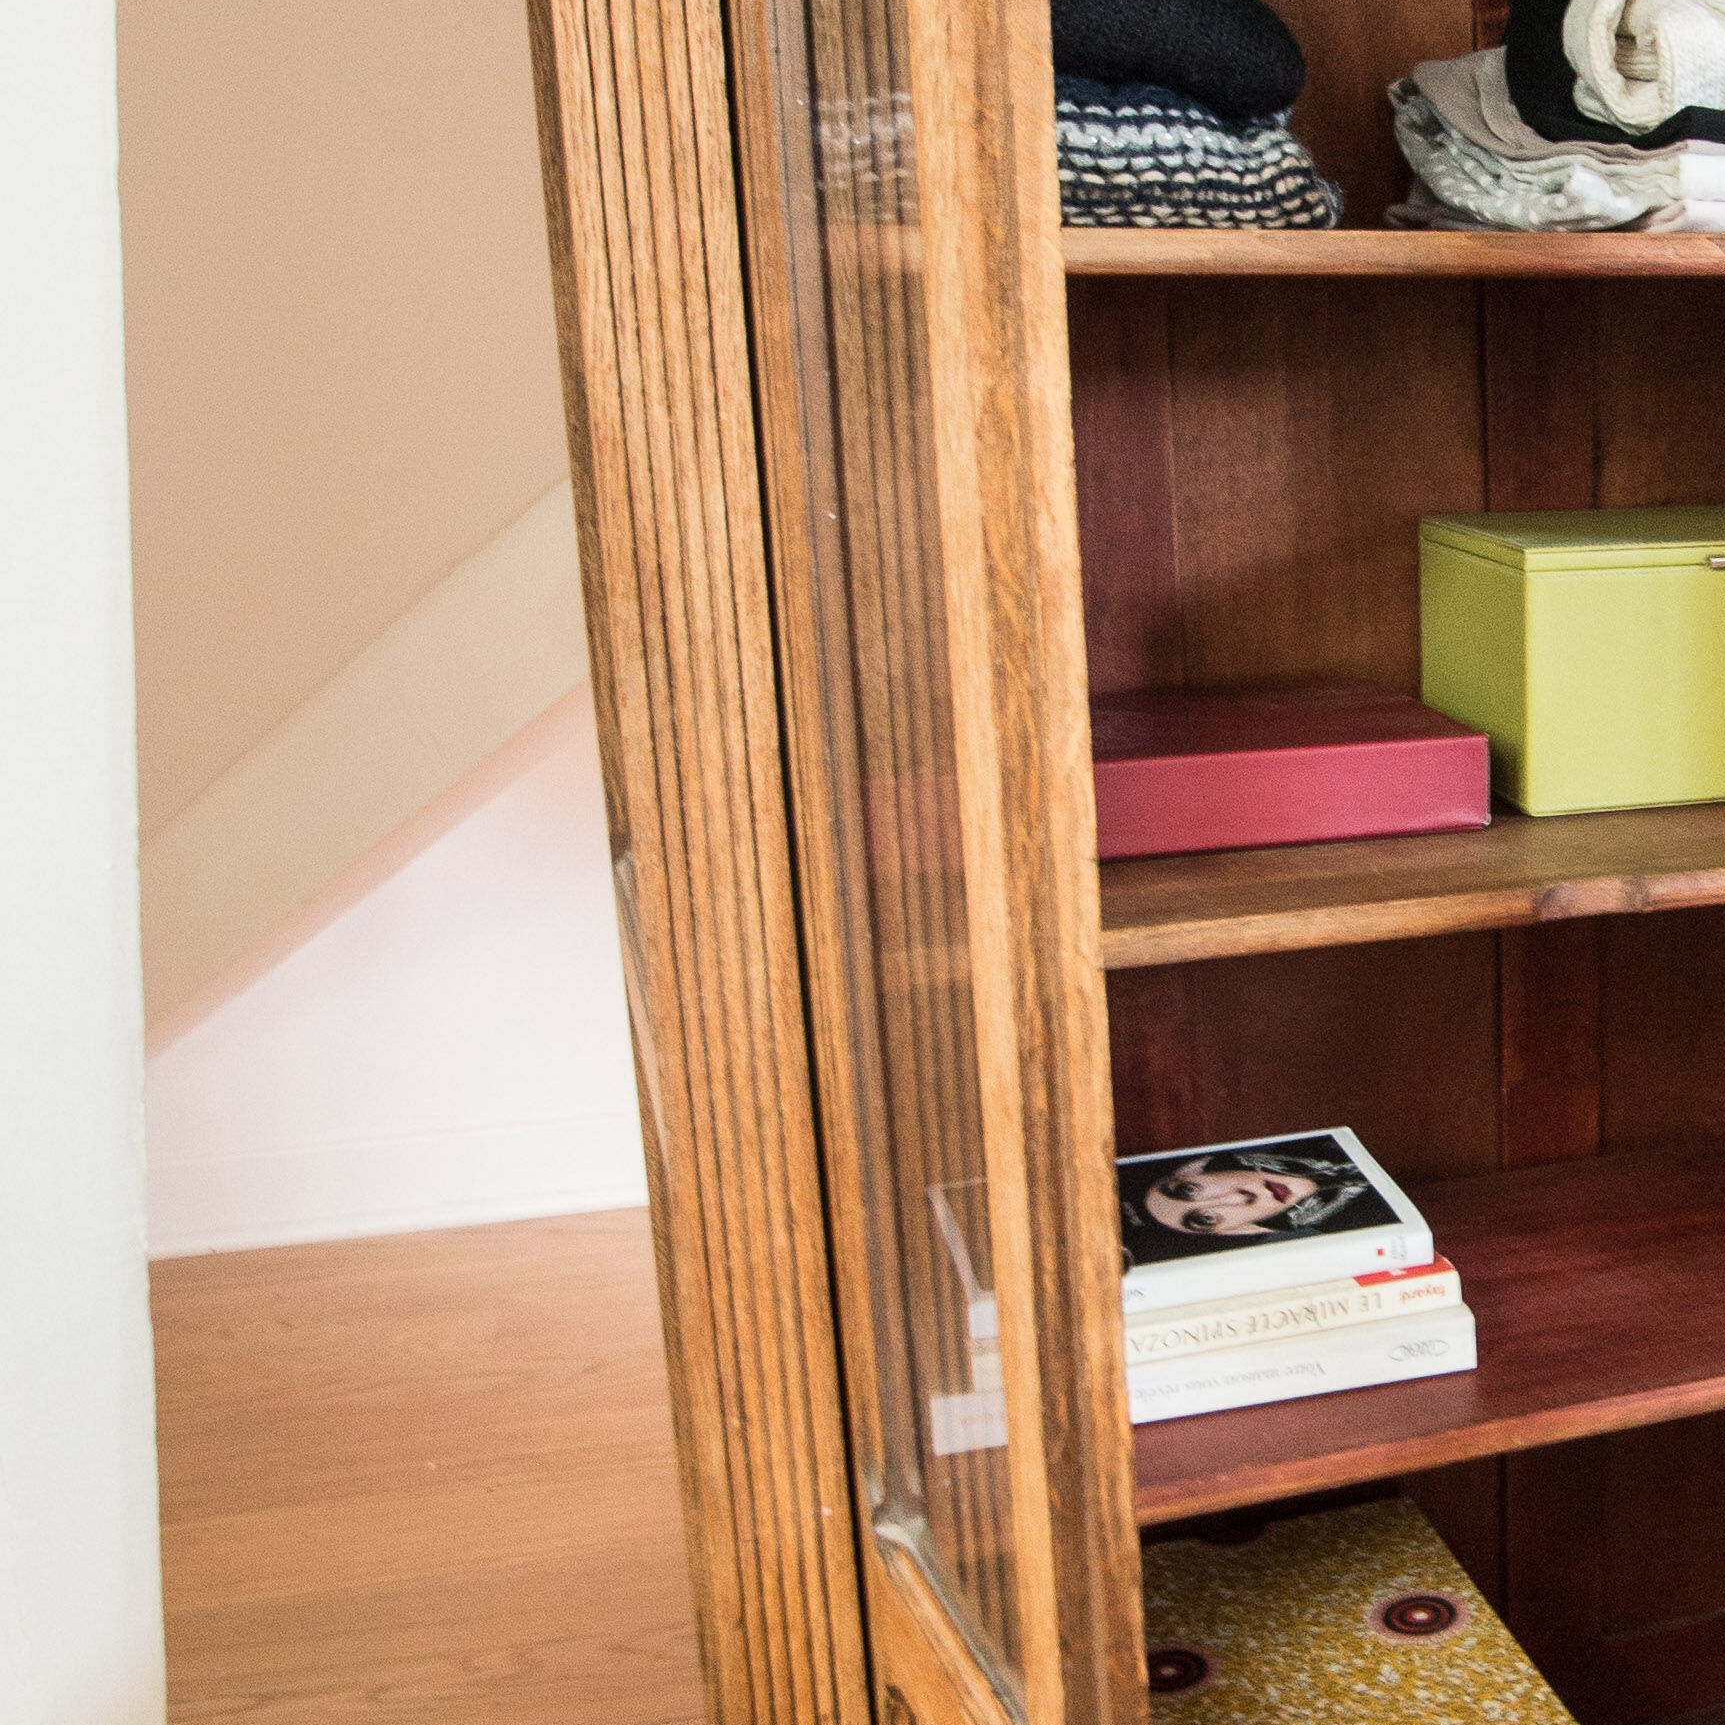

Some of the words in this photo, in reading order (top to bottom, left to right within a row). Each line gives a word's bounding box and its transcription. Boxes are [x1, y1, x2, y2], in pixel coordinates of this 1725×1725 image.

[1360, 1292, 1383, 1312] LE
[1247, 1297, 1349, 1333] MIRACLE
[1128, 1319, 1238, 1355] SPINOZA
[1284, 1361, 1326, 1378] Votre
[1183, 1379, 1222, 1392] vous
